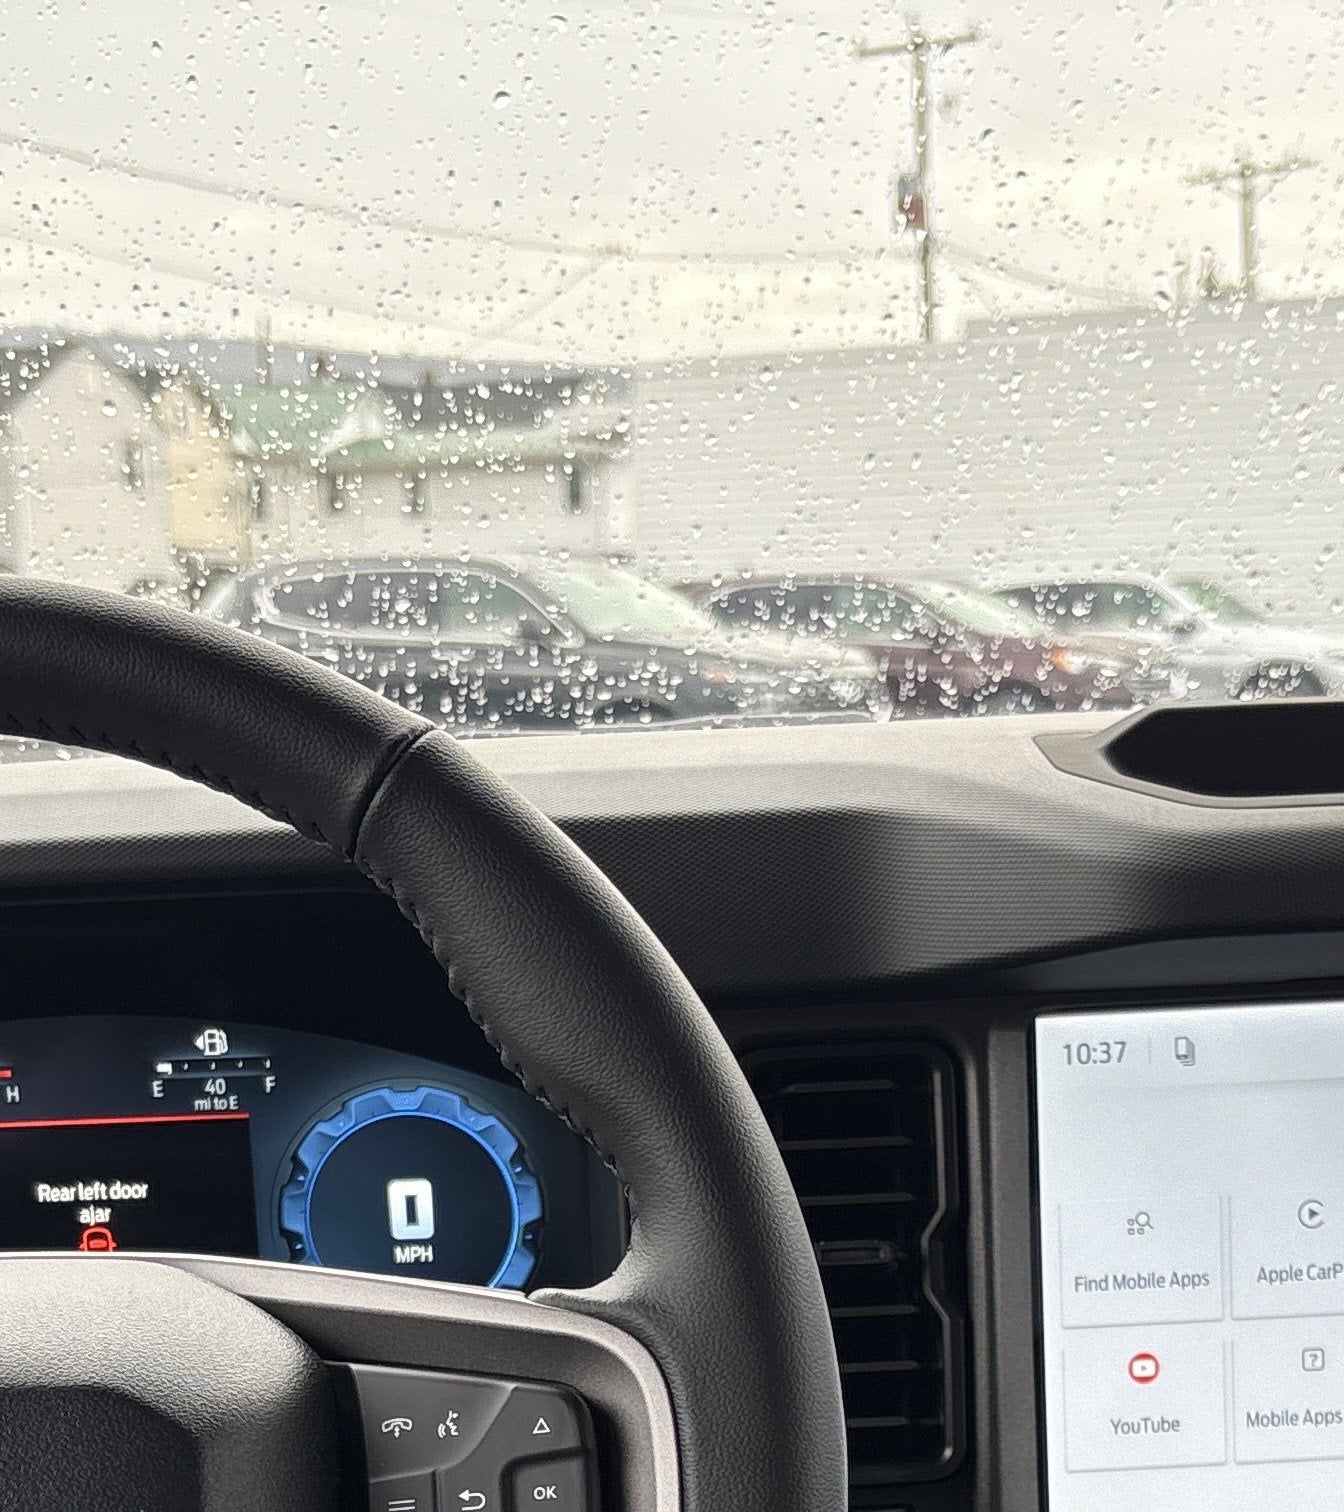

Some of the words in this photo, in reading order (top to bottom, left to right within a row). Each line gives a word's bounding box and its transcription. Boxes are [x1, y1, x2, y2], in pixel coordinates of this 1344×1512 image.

[1063, 1041, 1127, 1066] 10:37
[6, 1085, 20, 1104] H
[152, 1080, 165, 1098] E
[204, 1078, 226, 1096] 40
[264, 1075, 277, 1094] F
[194, 1097, 212, 1111] mi
[213, 1097, 228, 1111] to
[229, 1096, 239, 1110] E
[37, 1183, 76, 1202] Rear
[77, 1181, 108, 1201] left
[109, 1180, 148, 1200] door
[79, 1204, 112, 1226] ajar
[387, 1178, 435, 1240] 0
[393, 1244, 434, 1264] MPH
[1074, 1274, 1108, 1293] Find
[1112, 1271, 1166, 1292] Mobile
[1169, 1271, 1210, 1289] Apps
[1256, 1265, 1303, 1286] Apple
[1110, 1416, 1181, 1436] YouTube
[1246, 1408, 1299, 1428] Mobile
[1302, 1408, 1343, 1428] Apps
[533, 1485, 557, 1501] OK
